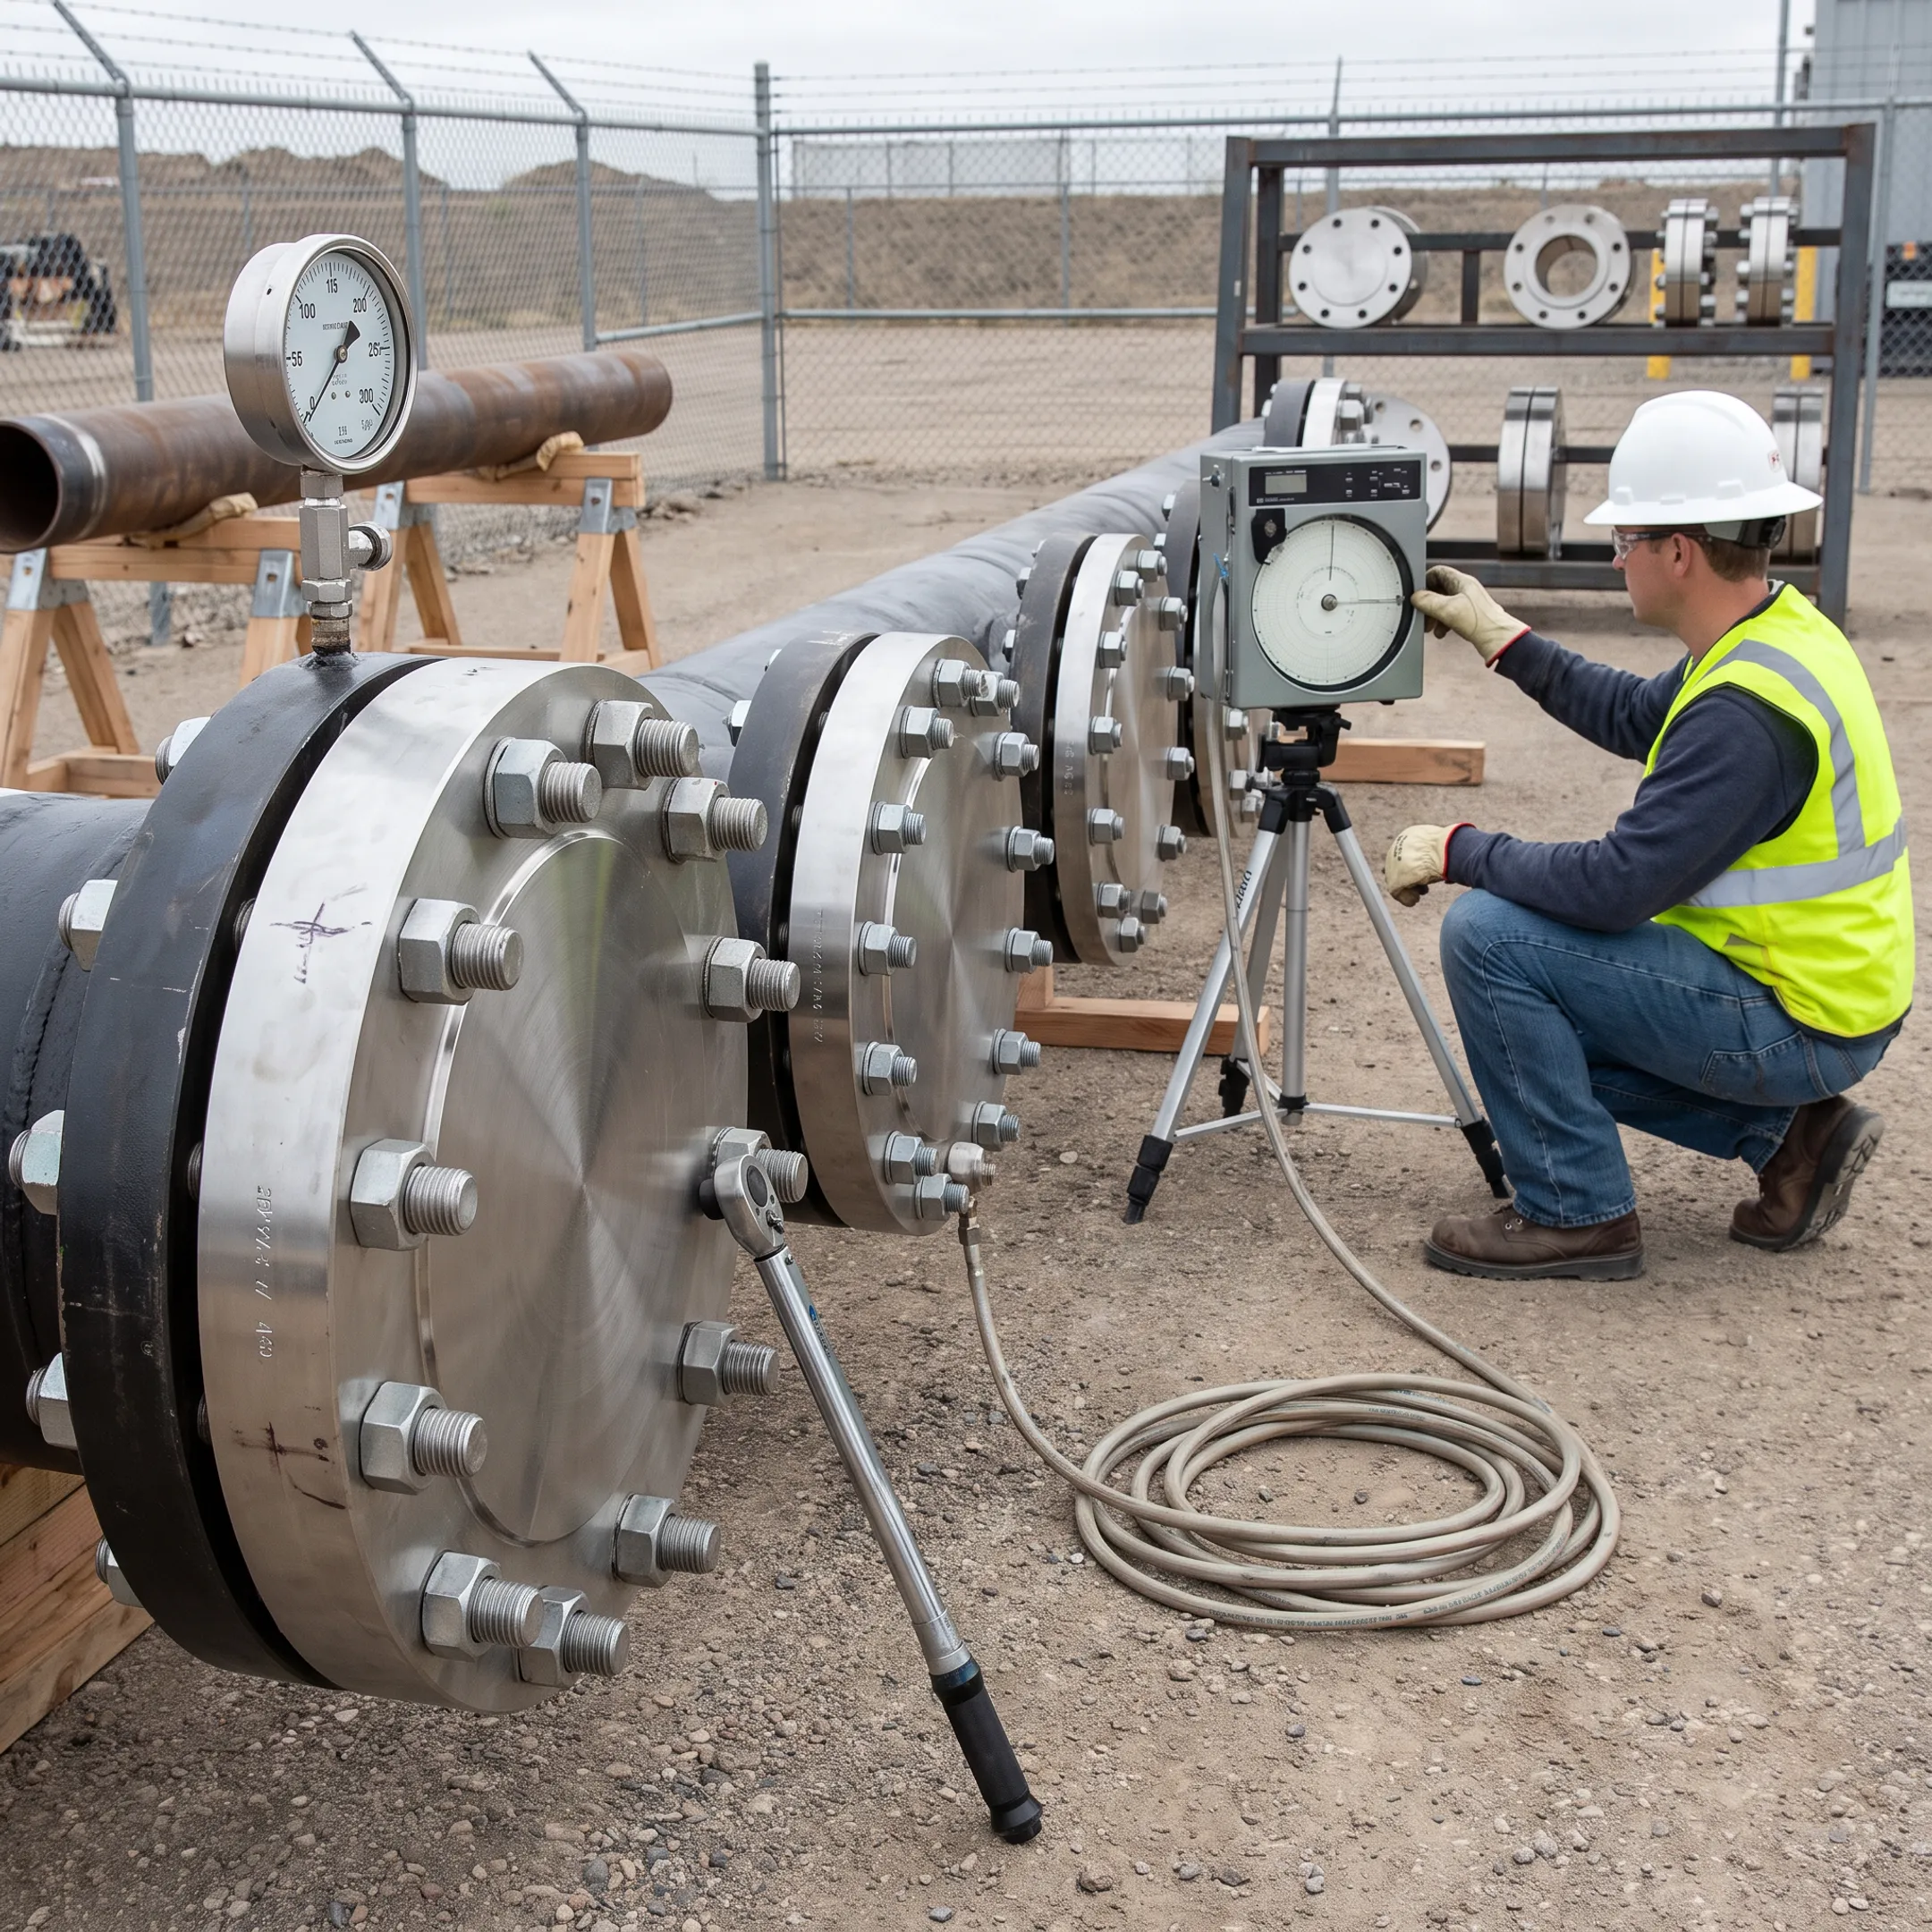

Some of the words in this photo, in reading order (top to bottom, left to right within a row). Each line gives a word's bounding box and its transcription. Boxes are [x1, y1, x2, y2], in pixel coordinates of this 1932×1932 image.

[326, 278, 338, 293] 115
[299, 302, 316, 318] 100
[353, 298, 367, 313] 200
